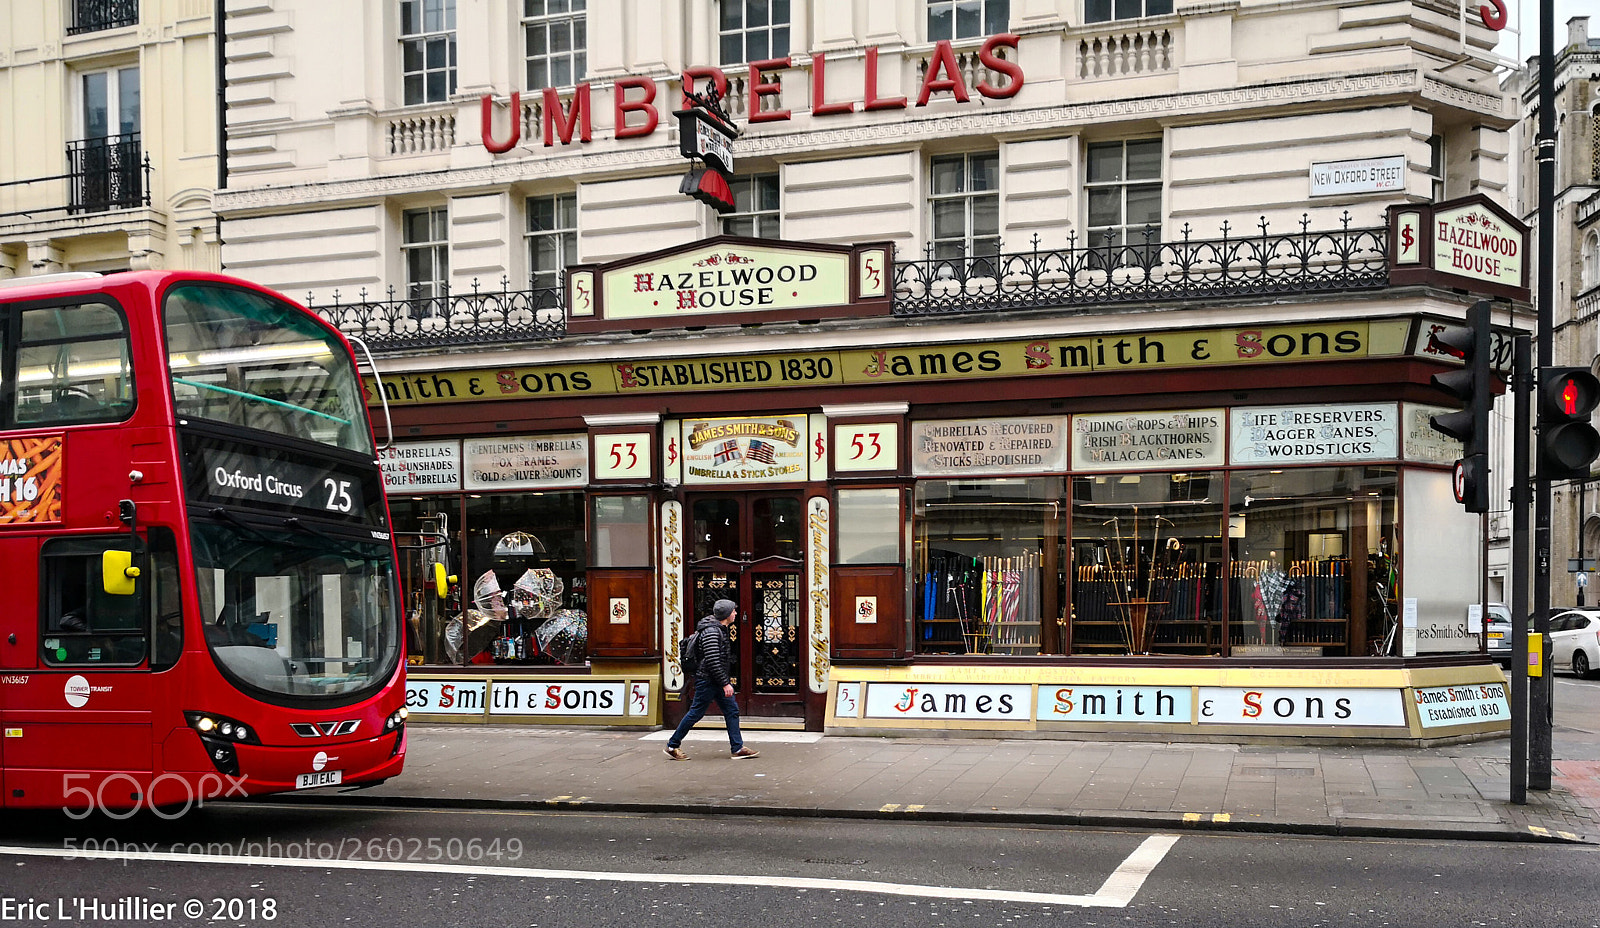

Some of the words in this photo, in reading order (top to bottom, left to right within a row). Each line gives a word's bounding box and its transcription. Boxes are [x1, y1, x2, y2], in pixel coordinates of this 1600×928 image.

[481, 33, 1025, 153] UMBRELLAS
[1314, 172, 1331, 186] NEW
[1334, 170, 1368, 184] OXFORD
[1370, 167, 1401, 181] STREET
[1438, 220, 1518, 257] HAZELWOOD
[864, 258, 881, 290] 53
[1452, 248, 1501, 277] HOUSE
[633, 264, 818, 293] HAZELWOOD
[576, 280, 590, 309] 53
[676, 287, 774, 310] HOUSE
[862, 347, 1002, 378] James
[1024, 336, 1166, 370] Smith
[1236, 330, 1362, 359] Sons
[496, 370, 592, 395] Sons
[616, 360, 773, 389] ESTABLISHED
[781, 357, 834, 382] 1830
[1076, 418, 1123, 433] RIDING
[1126, 416, 1165, 431] CROPS
[1242, 412, 1277, 426] LIFE
[691, 426, 725, 444] JAMES
[726, 423, 758, 436] SMITH
[758, 424, 766, 436] &
[1084, 433, 1117, 448] IRISH
[1250, 427, 1315, 441] DAGGER
[609, 442, 638, 469] 53
[849, 432, 882, 460] 53
[1090, 449, 1154, 462] MALACCA
[384, 474, 407, 486] GOLF
[408, 472, 457, 485] UMBRELLAS
[688, 465, 731, 479] UMBRELLA
[740, 468, 766, 478] STICK
[14, 476, 38, 501] 16
[215, 466, 263, 492] Oxford
[265, 475, 304, 499] Circus
[324, 478, 352, 513] 25
[1430, 624, 1453, 639] Smith
[1, 675, 29, 685] VN36157
[438, 684, 519, 709] Smith
[544, 684, 614, 710] Sons
[631, 685, 646, 713] 53
[841, 688, 855, 712] 53
[894, 686, 1014, 714] James
[1053, 688, 1175, 716] Smith
[1241, 690, 1352, 719] Sons
[1416, 689, 1448, 705] James
[1449, 688, 1475, 703] Smith
[1481, 686, 1504, 700] Sons
[1428, 705, 1477, 722] Established
[1480, 703, 1500, 717] 1830
[320, 772, 336, 785] EAC
